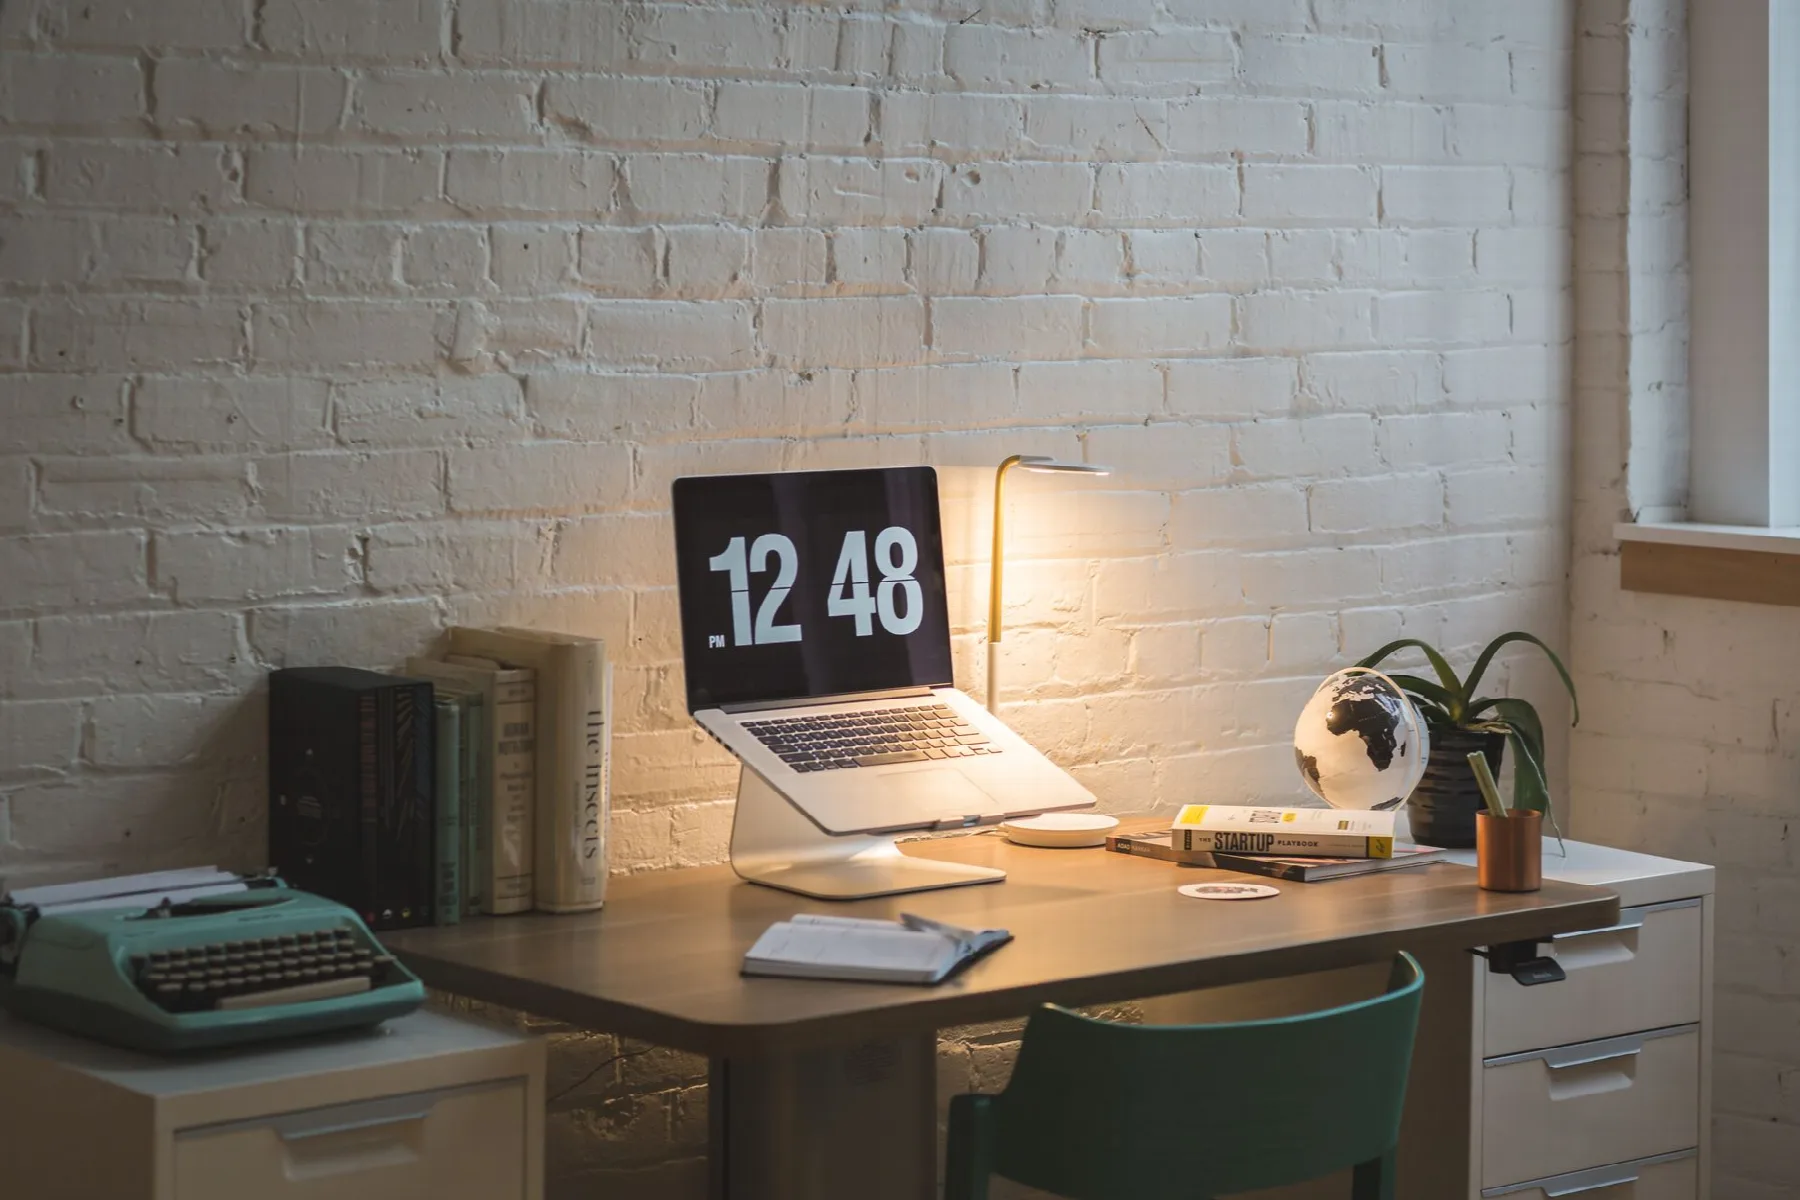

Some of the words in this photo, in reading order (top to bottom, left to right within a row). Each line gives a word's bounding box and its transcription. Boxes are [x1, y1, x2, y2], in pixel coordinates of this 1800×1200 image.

[709, 534, 802, 646] 12
[827, 526, 923, 636] 48
[709, 635, 725, 648] PM
[1214, 831, 1275, 851] STARTUP
